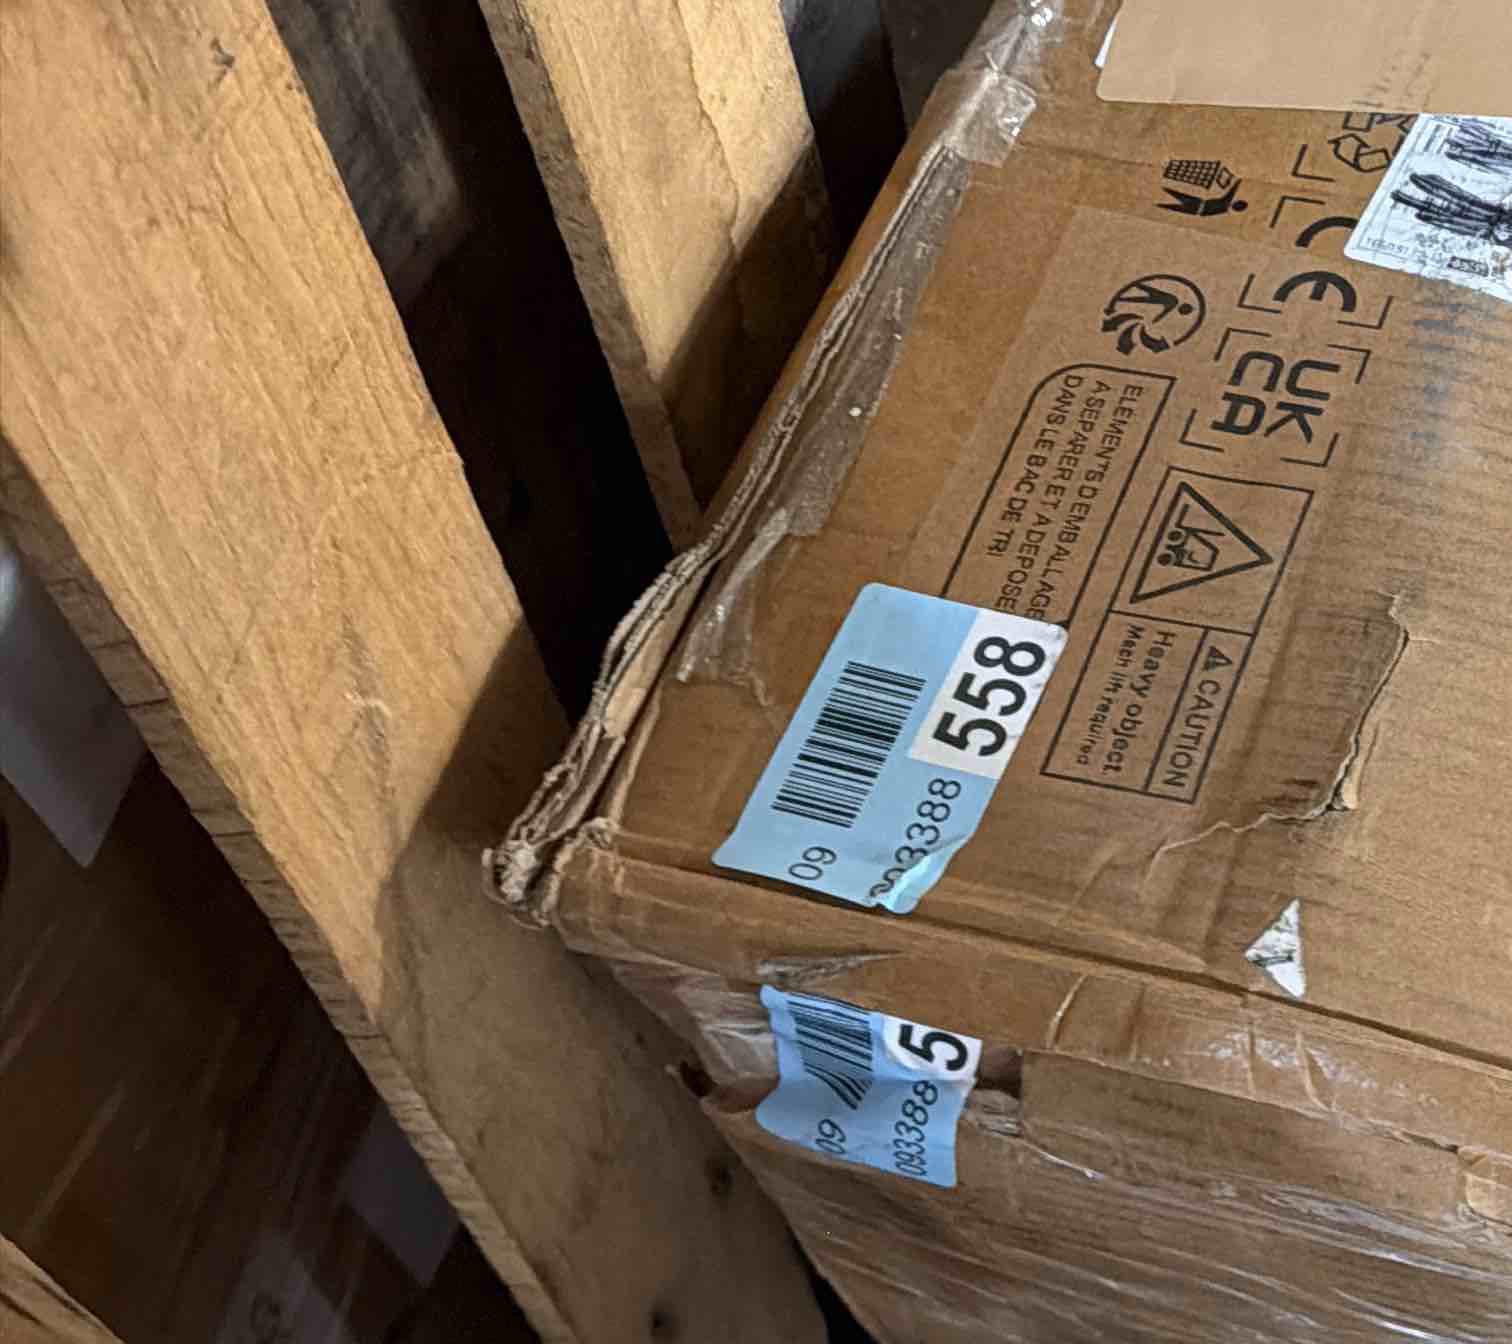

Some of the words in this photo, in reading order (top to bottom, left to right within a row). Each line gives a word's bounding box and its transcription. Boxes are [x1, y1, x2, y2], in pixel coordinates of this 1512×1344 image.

[1045, 373, 1084, 426] DANS
[1013, 453, 1049, 496] BAC
[1000, 496, 1030, 524] DE
[986, 527, 1015, 558] TRI
[1118, 622, 1147, 668] Mech
[1129, 630, 1178, 698] Heavy
[931, 635, 1048, 757] 558
[1076, 694, 1115, 766] required
[1162, 678, 1223, 789] CAUTION
[788, 845, 838, 883] 09
[897, 1022, 969, 1072] 5
[814, 1117, 848, 1155] 09
[891, 1079, 939, 1177] 093388
